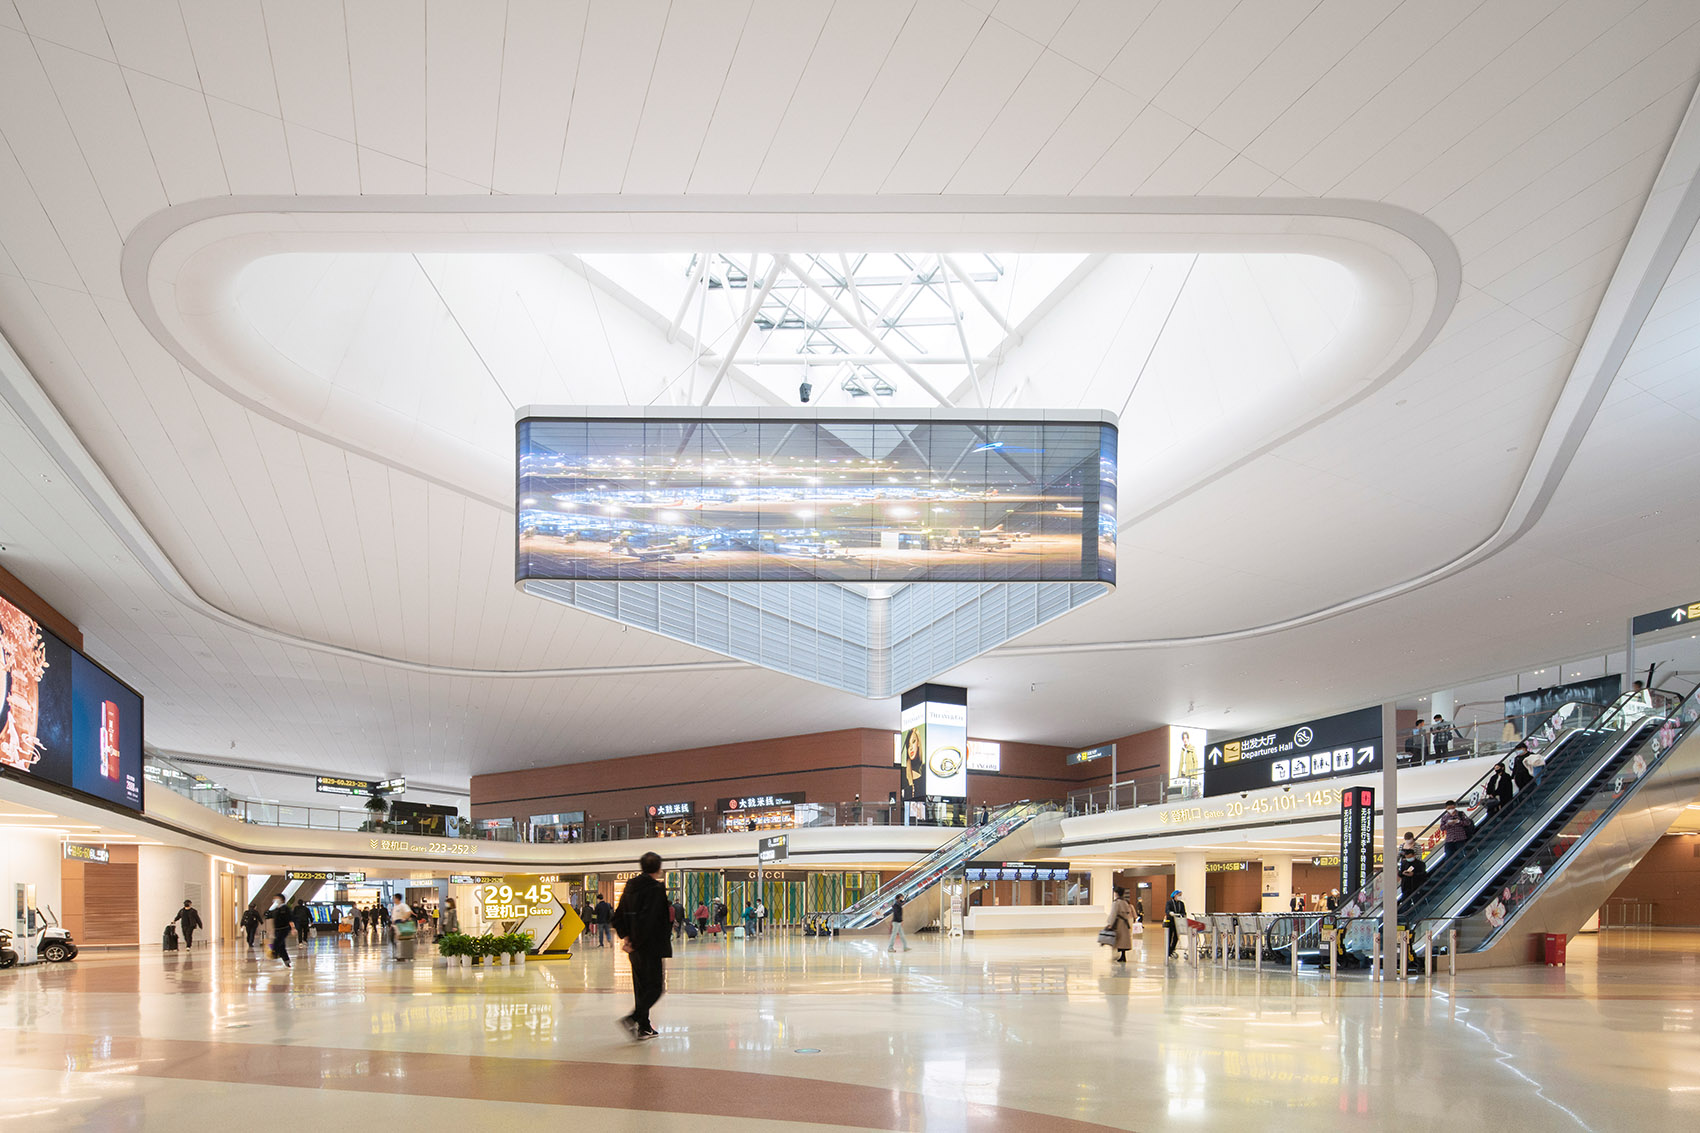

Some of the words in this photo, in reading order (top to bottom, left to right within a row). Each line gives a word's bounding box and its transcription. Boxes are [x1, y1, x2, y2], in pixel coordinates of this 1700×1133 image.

[1241, 734, 1277, 752] 出发大厅
[1241, 746, 1277, 760] Departures
[1279, 742, 1294, 752] Hall
[1171, 807, 1201, 822] 登机口
[1204, 811, 1224, 820] Gates
[381, 839, 409, 851] 登机口
[410, 845, 428, 853] Gates
[429, 842, 469, 854] 223-252
[300, 872, 326, 880] 223-252
[748, 871, 785, 879] GUCCI
[484, 884, 553, 904] 29-45
[485, 904, 528, 919] 登机口
[529, 906, 553, 916] Gates
